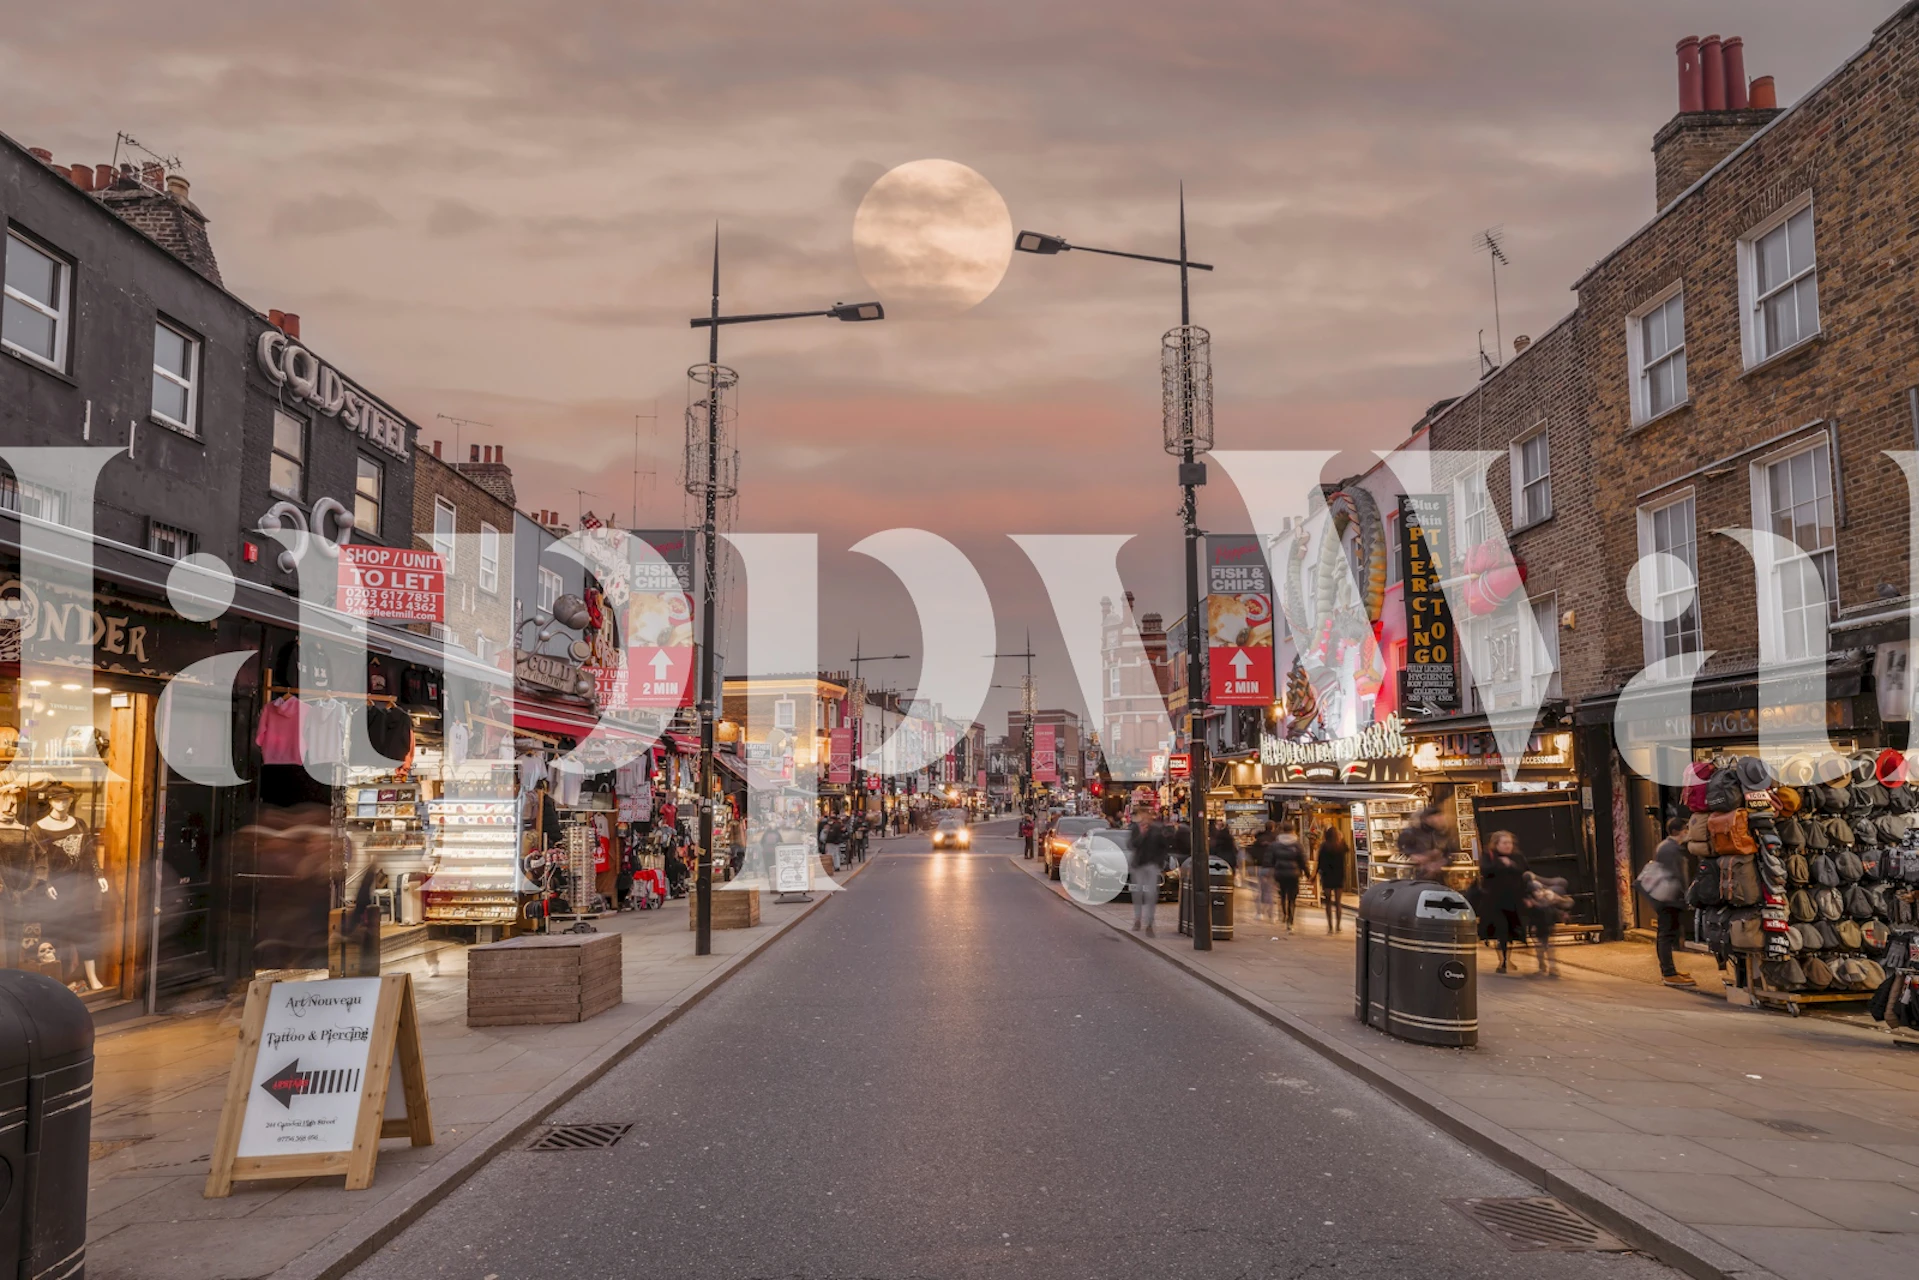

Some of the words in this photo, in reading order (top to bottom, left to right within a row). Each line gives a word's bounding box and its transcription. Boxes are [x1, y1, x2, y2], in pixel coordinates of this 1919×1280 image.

[345, 547, 390, 565] SHOP
[402, 552, 440, 570] UNIT
[636, 564, 672, 576] FISH
[677, 564, 689, 577] &
[1211, 568, 1248, 579] FISH
[1251, 567, 1264, 579] &
[349, 568, 385, 587] TO
[391, 572, 435, 591] LET
[636, 576, 690, 589] CHIPS
[1212, 578, 1265, 591] CHIPS
[346, 588, 378, 599] 0203
[380, 591, 405, 602] 617
[407, 594, 436, 603] 7851
[1409, 527, 1431, 663] PIERCING
[1427, 529, 1448, 663] TATTOO
[345, 597, 377, 608] 0742
[380, 600, 403, 610] 413
[406, 602, 436, 613] 4362
[346, 607, 437, 621] Zak@fleetmill.com
[528, 656, 572, 681] COLD
[1408, 673, 1454, 681] HYGIENIC
[642, 683, 651, 695] 2
[653, 682, 679, 695] MIN
[1224, 681, 1233, 694] 2
[1235, 681, 1259, 694] MIN
[267, 1027, 305, 1051] Tattoo
[308, 1030, 317, 1041] &
[320, 1024, 369, 1045] Piercing
